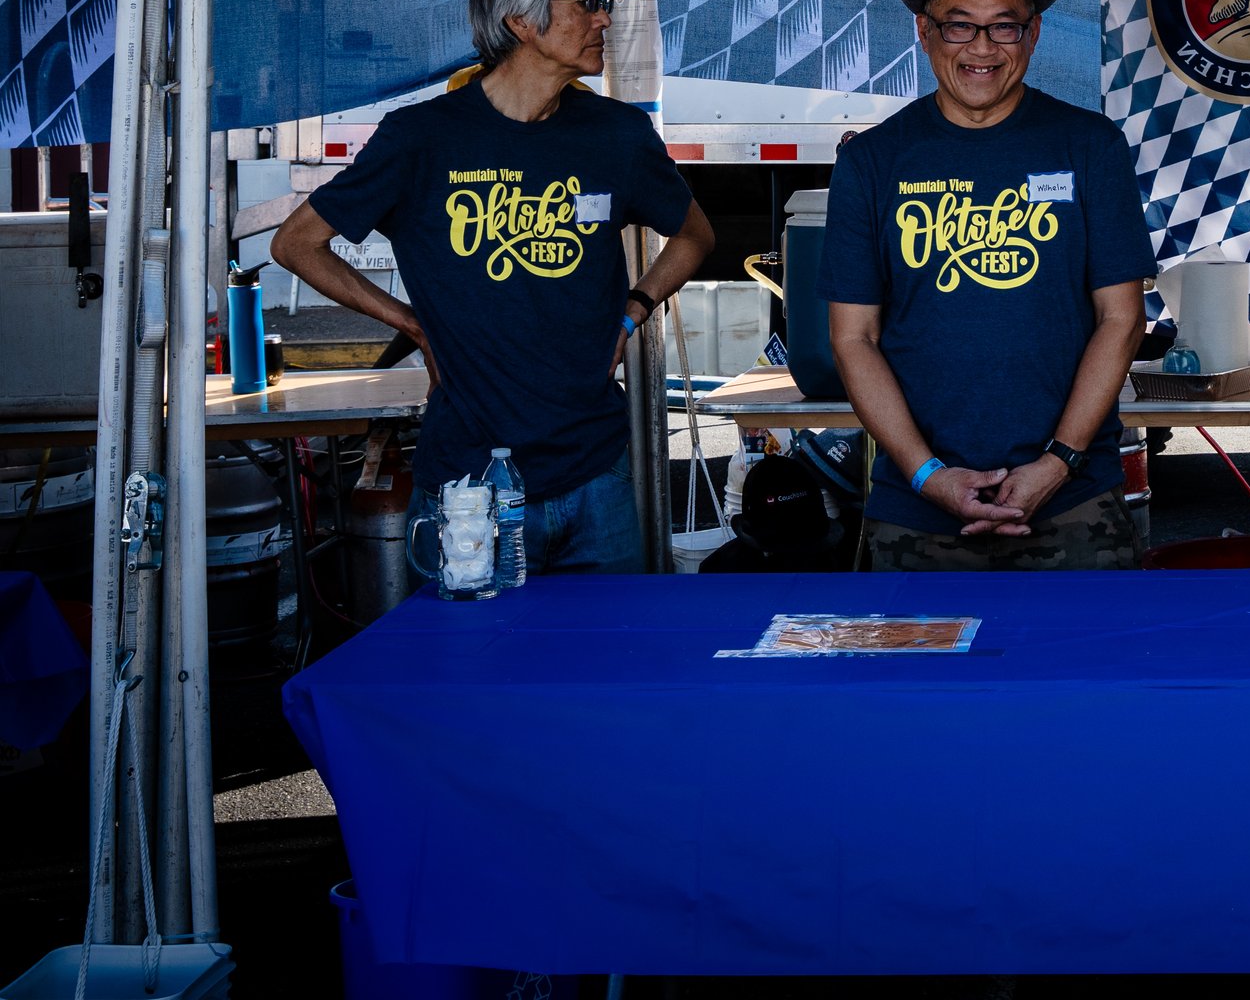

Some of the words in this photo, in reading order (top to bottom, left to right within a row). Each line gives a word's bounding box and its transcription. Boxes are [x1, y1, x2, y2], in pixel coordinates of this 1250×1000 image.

[449, 168, 497, 183] Mountain
[500, 169, 523, 182] View
[899, 180, 946, 194] Mountain
[949, 179, 974, 192] View
[1037, 184, 1067, 192] Wilhelm
[531, 242, 566, 263] FEST
[366, 258, 393, 267] VIEW
[981, 251, 1019, 273] FEST
